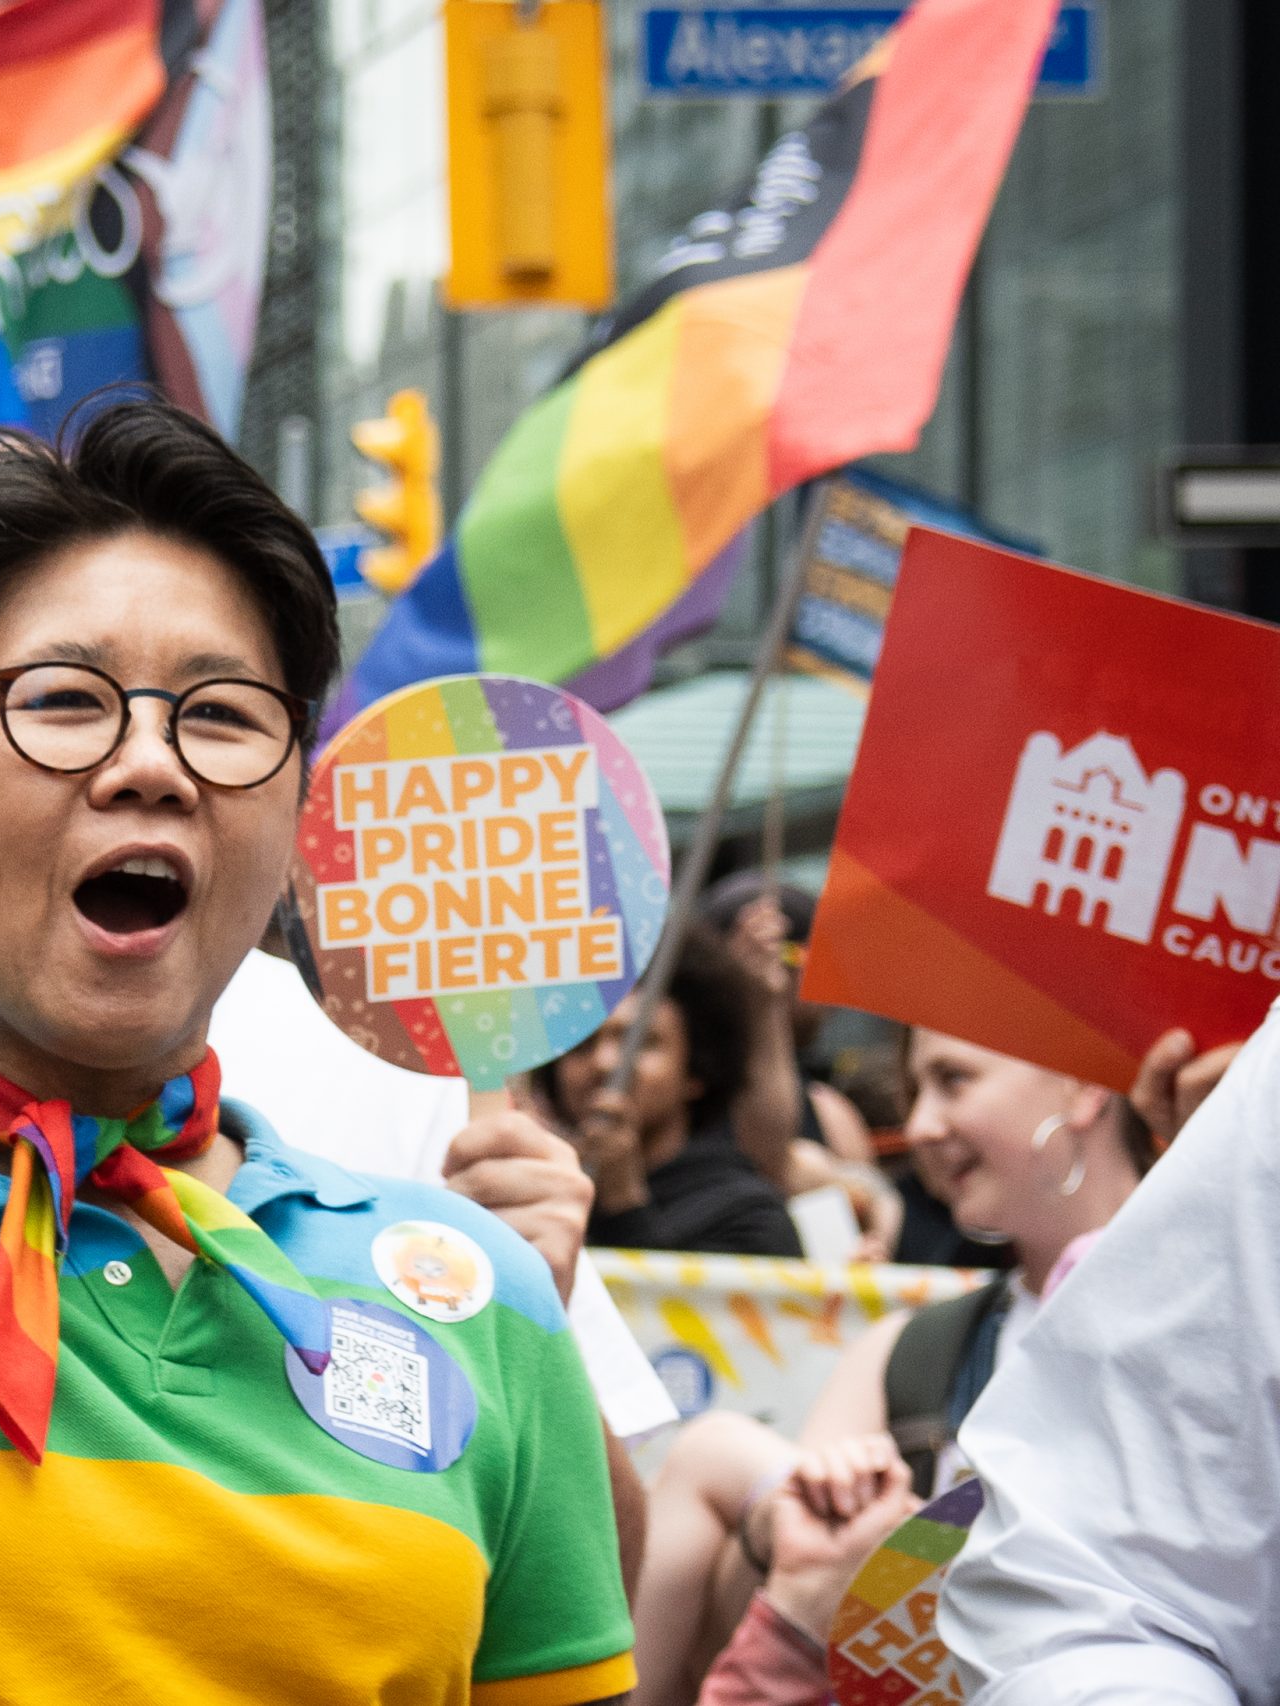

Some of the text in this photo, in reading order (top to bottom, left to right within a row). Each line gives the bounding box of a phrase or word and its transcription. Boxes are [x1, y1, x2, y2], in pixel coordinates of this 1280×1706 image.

[339, 750, 590, 824] HAPPY
[361, 809, 580, 880] PRIDE
[322, 868, 584, 942] BONNE
[371, 905, 619, 995] FIERTÉ
